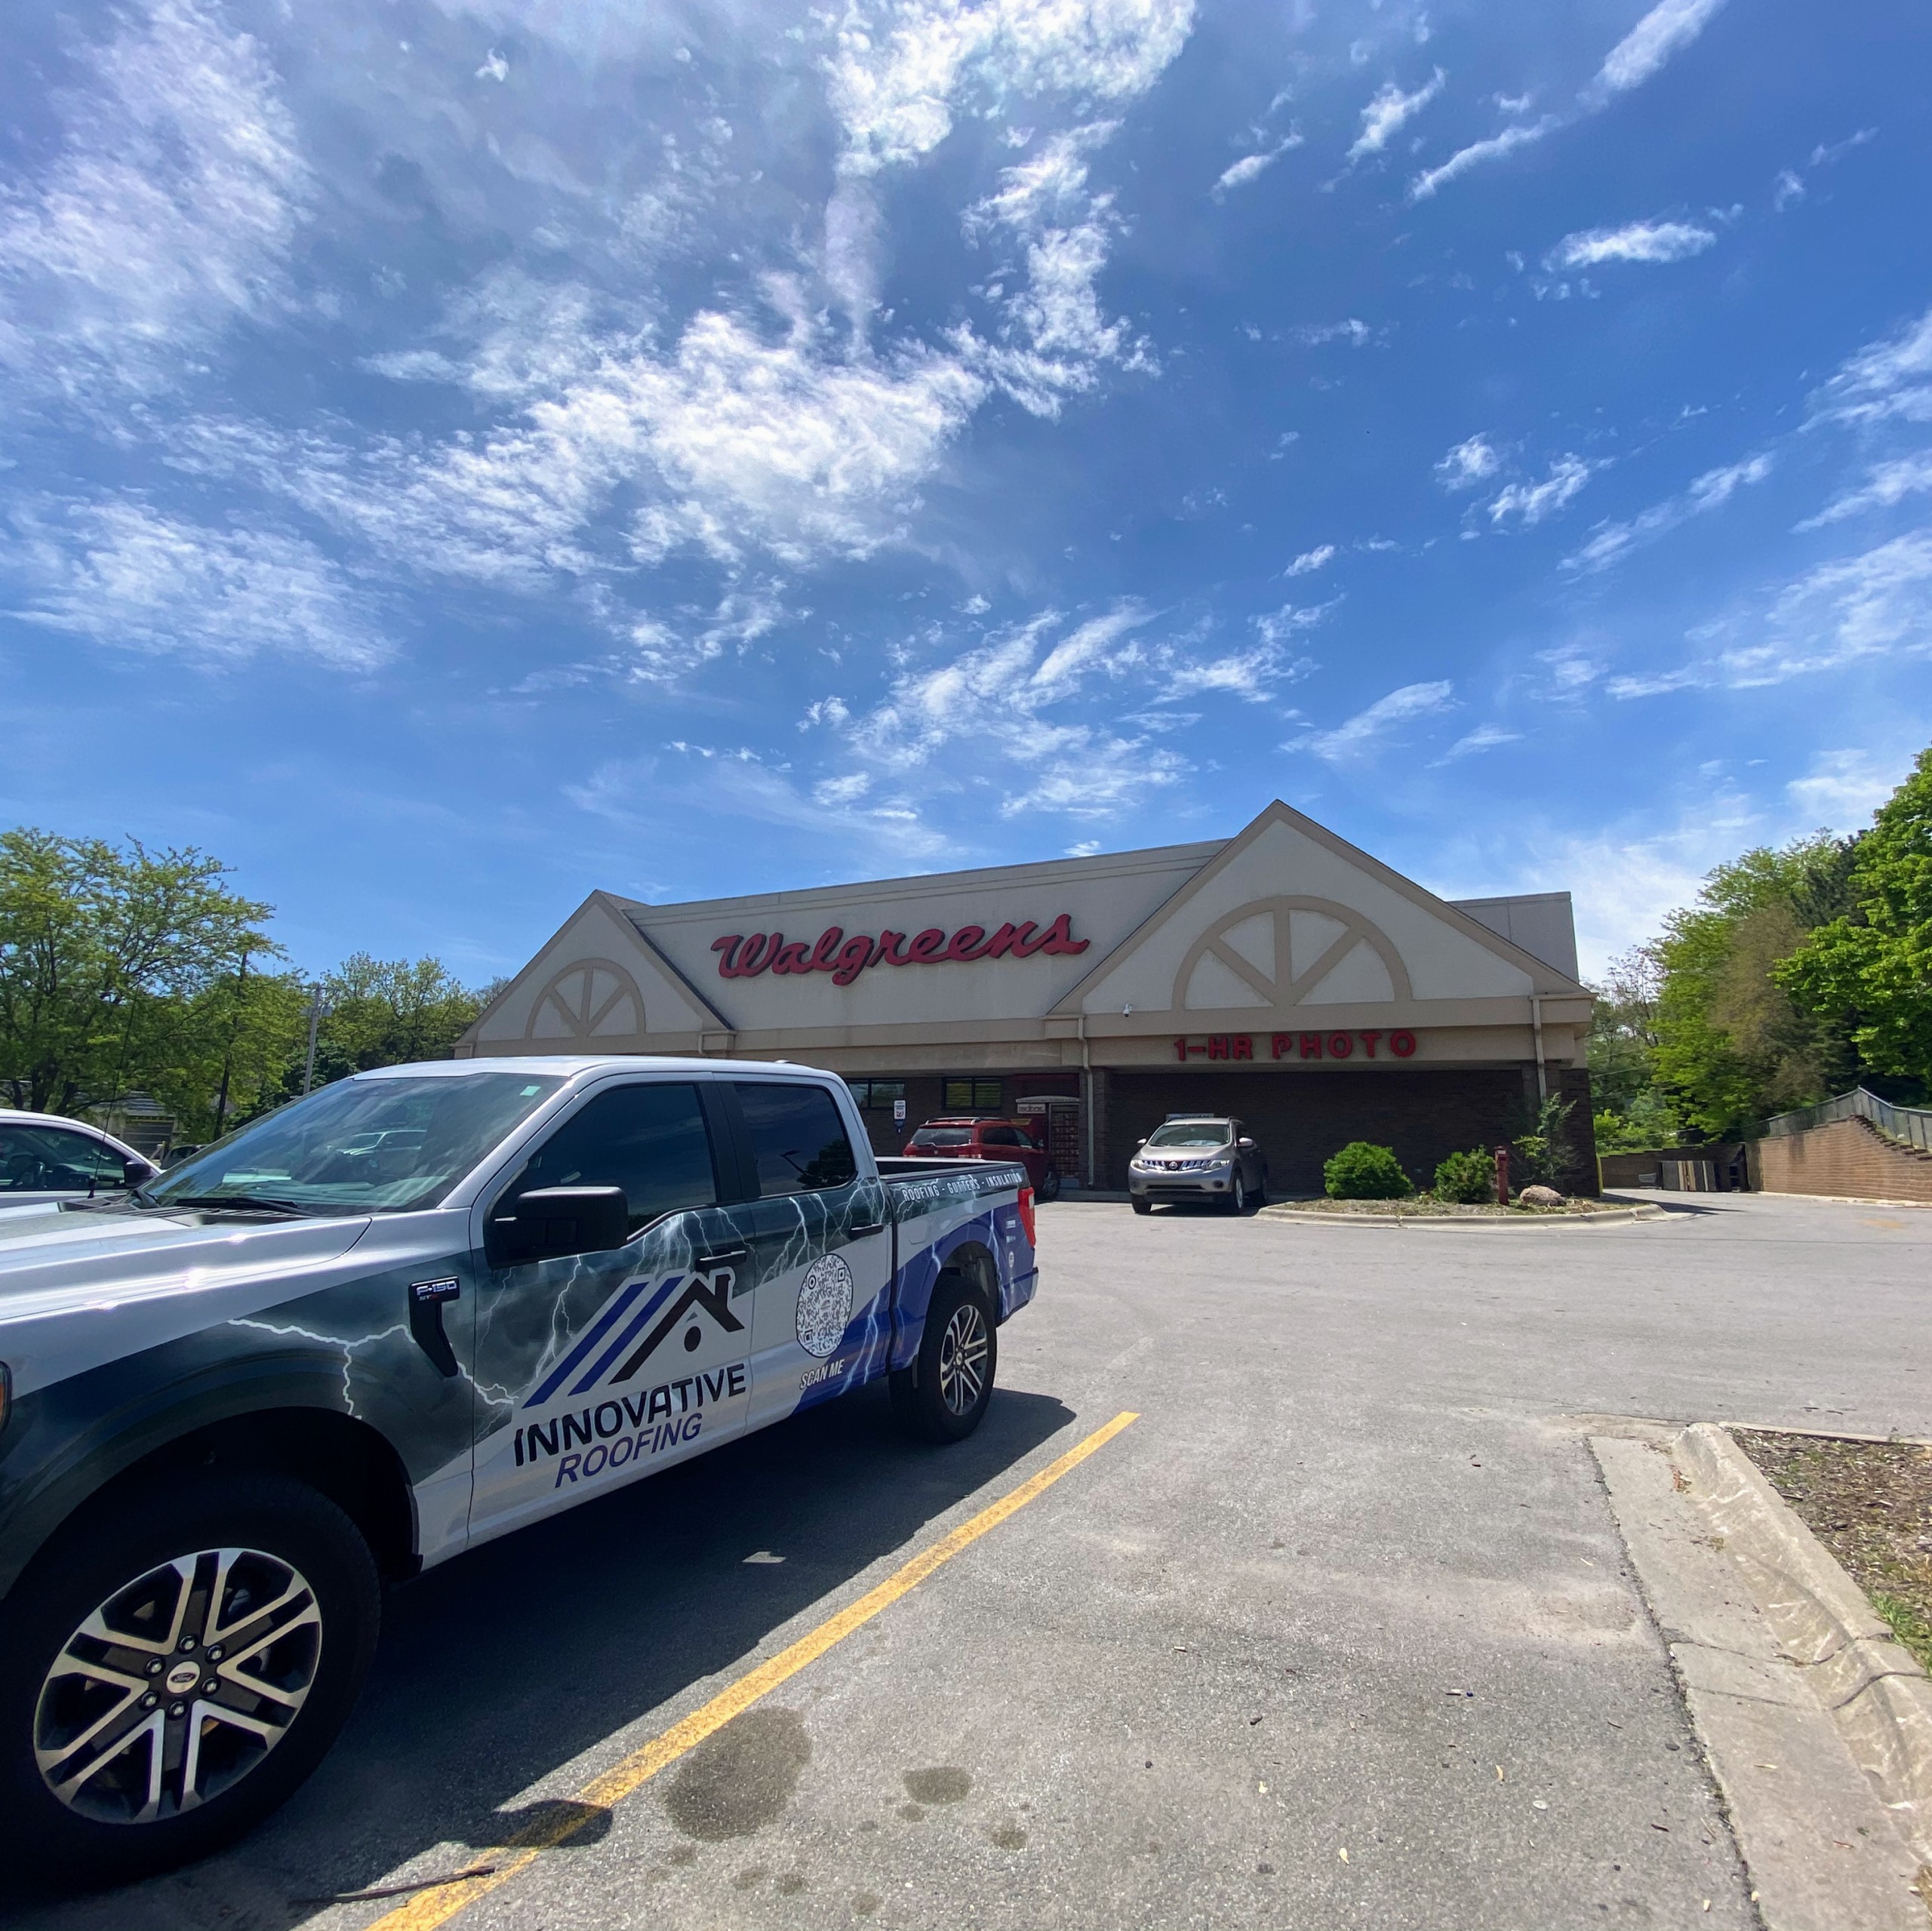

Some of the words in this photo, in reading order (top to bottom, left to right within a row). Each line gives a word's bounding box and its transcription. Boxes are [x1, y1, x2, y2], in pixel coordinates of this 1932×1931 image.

[711, 913, 1090, 986] Walgreens
[1174, 1035, 1254, 1061] 1-HR
[1272, 1029, 1417, 1060] PHOTO
[902, 1185, 940, 1201] ROOFING
[946, 1178, 981, 1195] GUTTERS
[985, 1172, 1023, 1188] INSULATION
[799, 1364, 829, 1389] SCAN
[829, 1358, 845, 1378] ME
[514, 1364, 746, 1467] INNOVATIVE
[555, 1412, 703, 1489] ROOFING
